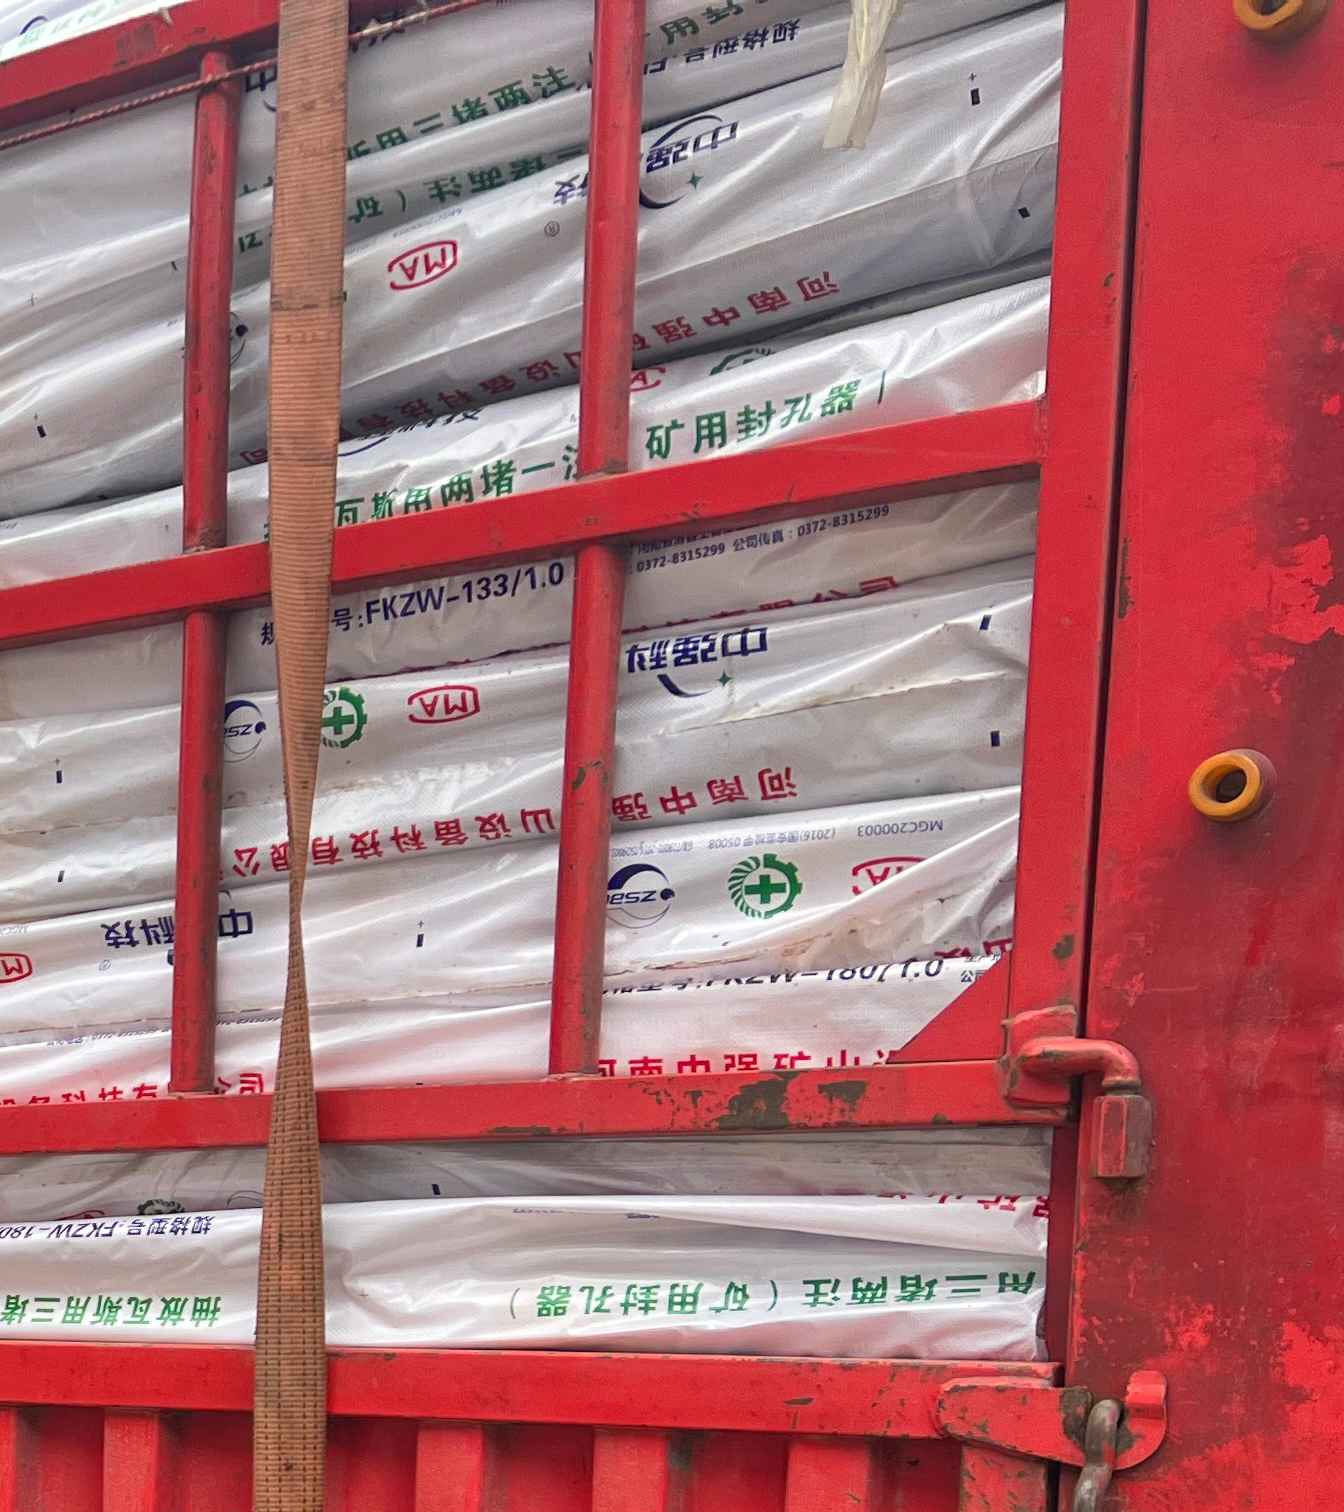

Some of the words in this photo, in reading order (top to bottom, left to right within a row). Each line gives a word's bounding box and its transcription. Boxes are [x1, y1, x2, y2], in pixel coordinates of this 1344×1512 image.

[856, 818, 945, 838] MGC200003
[100, 907, 253, 950] 中科技
